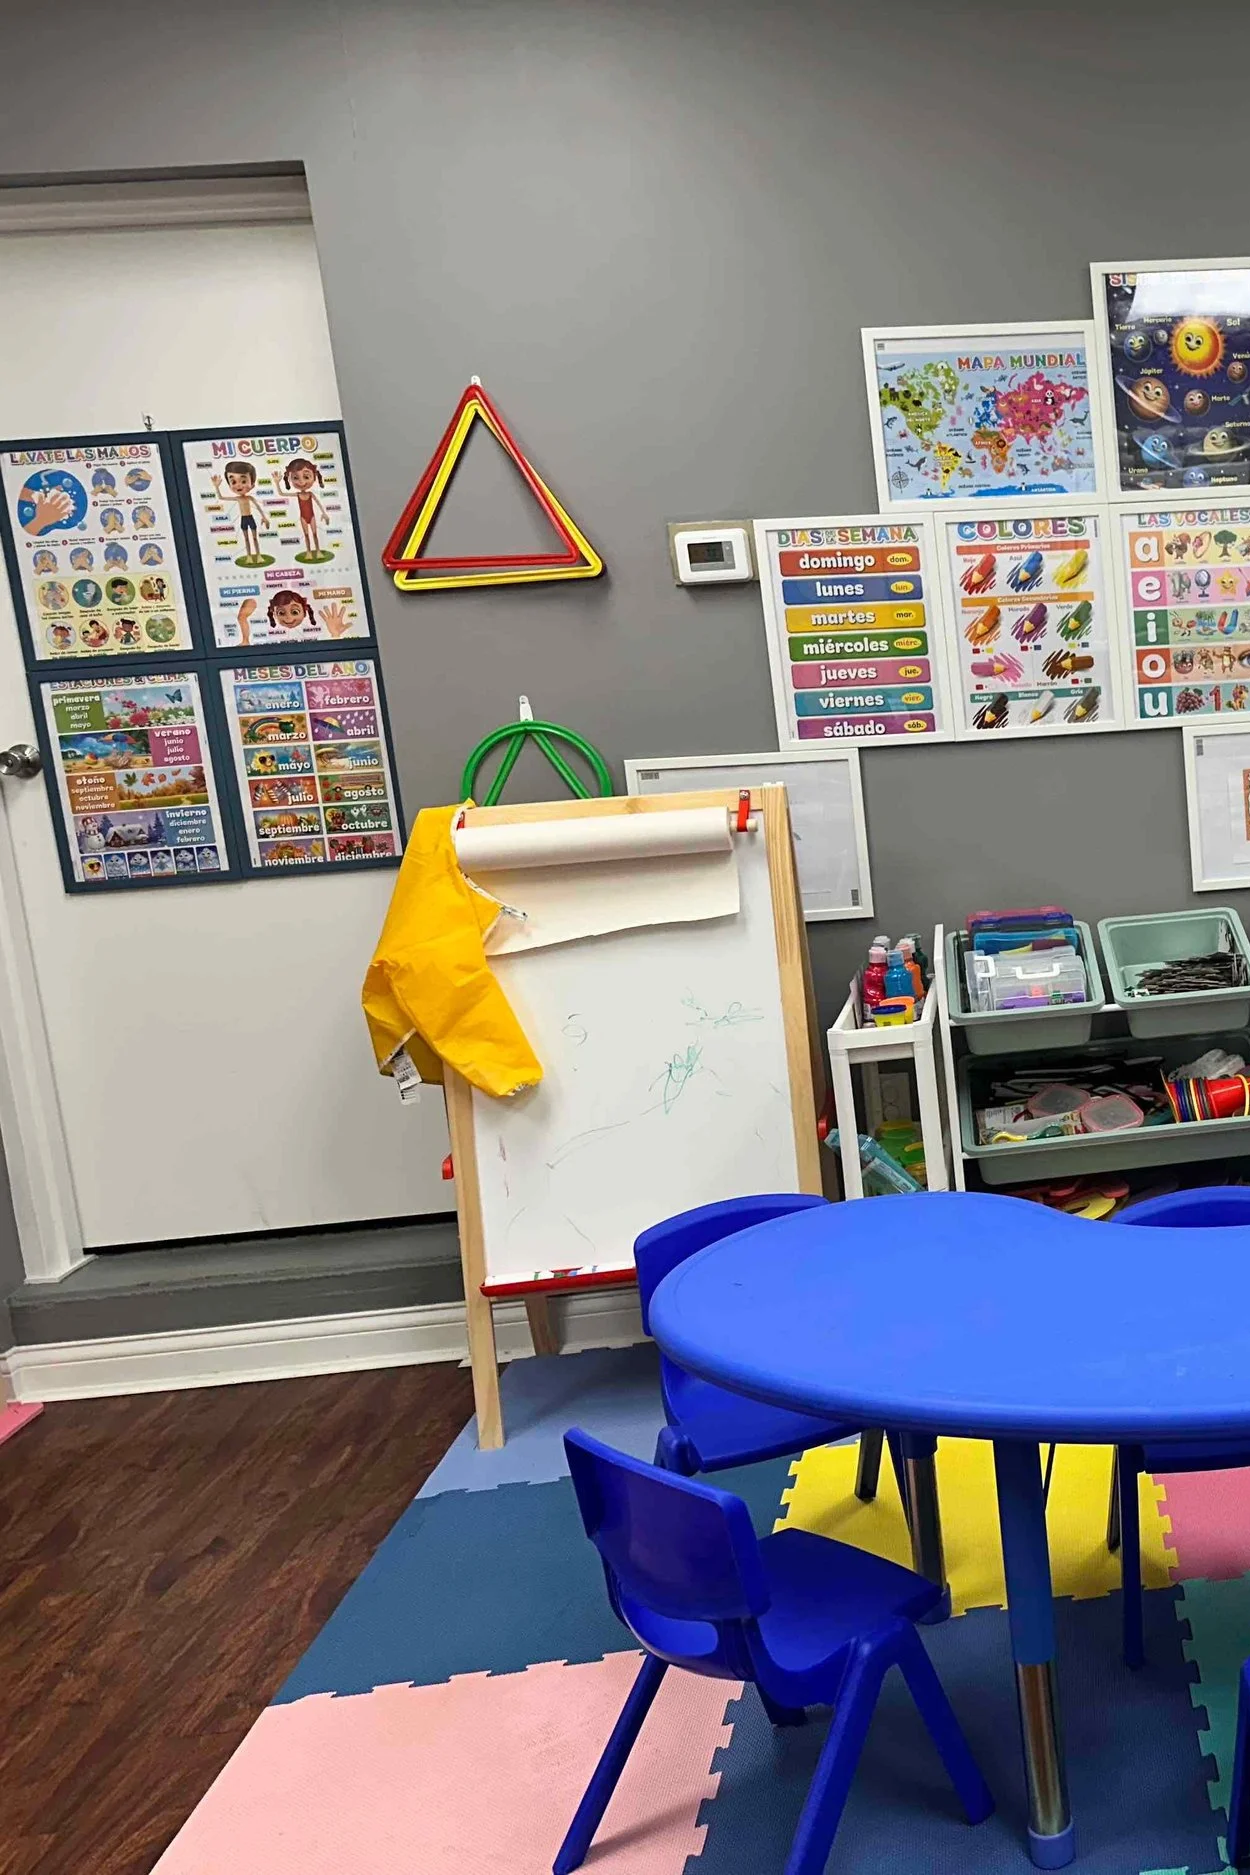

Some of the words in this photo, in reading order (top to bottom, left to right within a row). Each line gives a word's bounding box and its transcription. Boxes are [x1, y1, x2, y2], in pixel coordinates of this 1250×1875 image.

[1226, 318, 1240, 326] Sol
[957, 356, 1006, 371] MAPA
[1010, 353, 1086, 369] MUNDIAL
[66, 449, 94, 461] LAS
[97, 446, 150, 459] MANOS
[211, 441, 235, 457] MI
[237, 436, 317, 455] CUERPO
[1138, 513, 1171, 526] LAS
[838, 526, 919, 544] SEMANA
[958, 518, 1086, 540] COLORES
[1135, 537, 1159, 562] a
[799, 551, 875, 572] domingo
[889, 555, 909, 563] dom.
[816, 582, 864, 596] lunes
[895, 583, 910, 591] lun.
[1138, 576, 1161, 601] e
[811, 611, 876, 625] martes
[1147, 612, 1157, 642] i
[803, 637, 889, 656] miércoles
[233, 665, 292, 681] MESES
[294, 664, 328, 677] DEL
[1142, 654, 1166, 678] o
[820, 665, 877, 685] jueves
[904, 667, 919, 676] jue.
[53, 695, 100, 706] primavera
[265, 700, 300, 709] enero
[324, 695, 369, 705] febrero
[819, 693, 884, 709] viernes
[904, 694, 922, 702] vier.
[1144, 692, 1167, 717] u
[154, 729, 191, 737] verano
[346, 727, 375, 736] abril
[824, 720, 886, 737] sábado
[164, 737, 184, 745] junio
[268, 732, 306, 741] marzo
[167, 746, 184, 754] julio
[164, 755, 190, 763] agosto
[278, 761, 311, 771] mayo
[348, 756, 378, 770] junio
[76, 777, 105, 785] otoño
[287, 792, 314, 804] julio
[344, 787, 384, 800] agosto
[166, 809, 207, 818] invierno
[258, 822, 320, 838] septiembre
[341, 819, 387, 830] octubre
[265, 854, 324, 867] noviembre
[335, 851, 392, 861] diciembre
